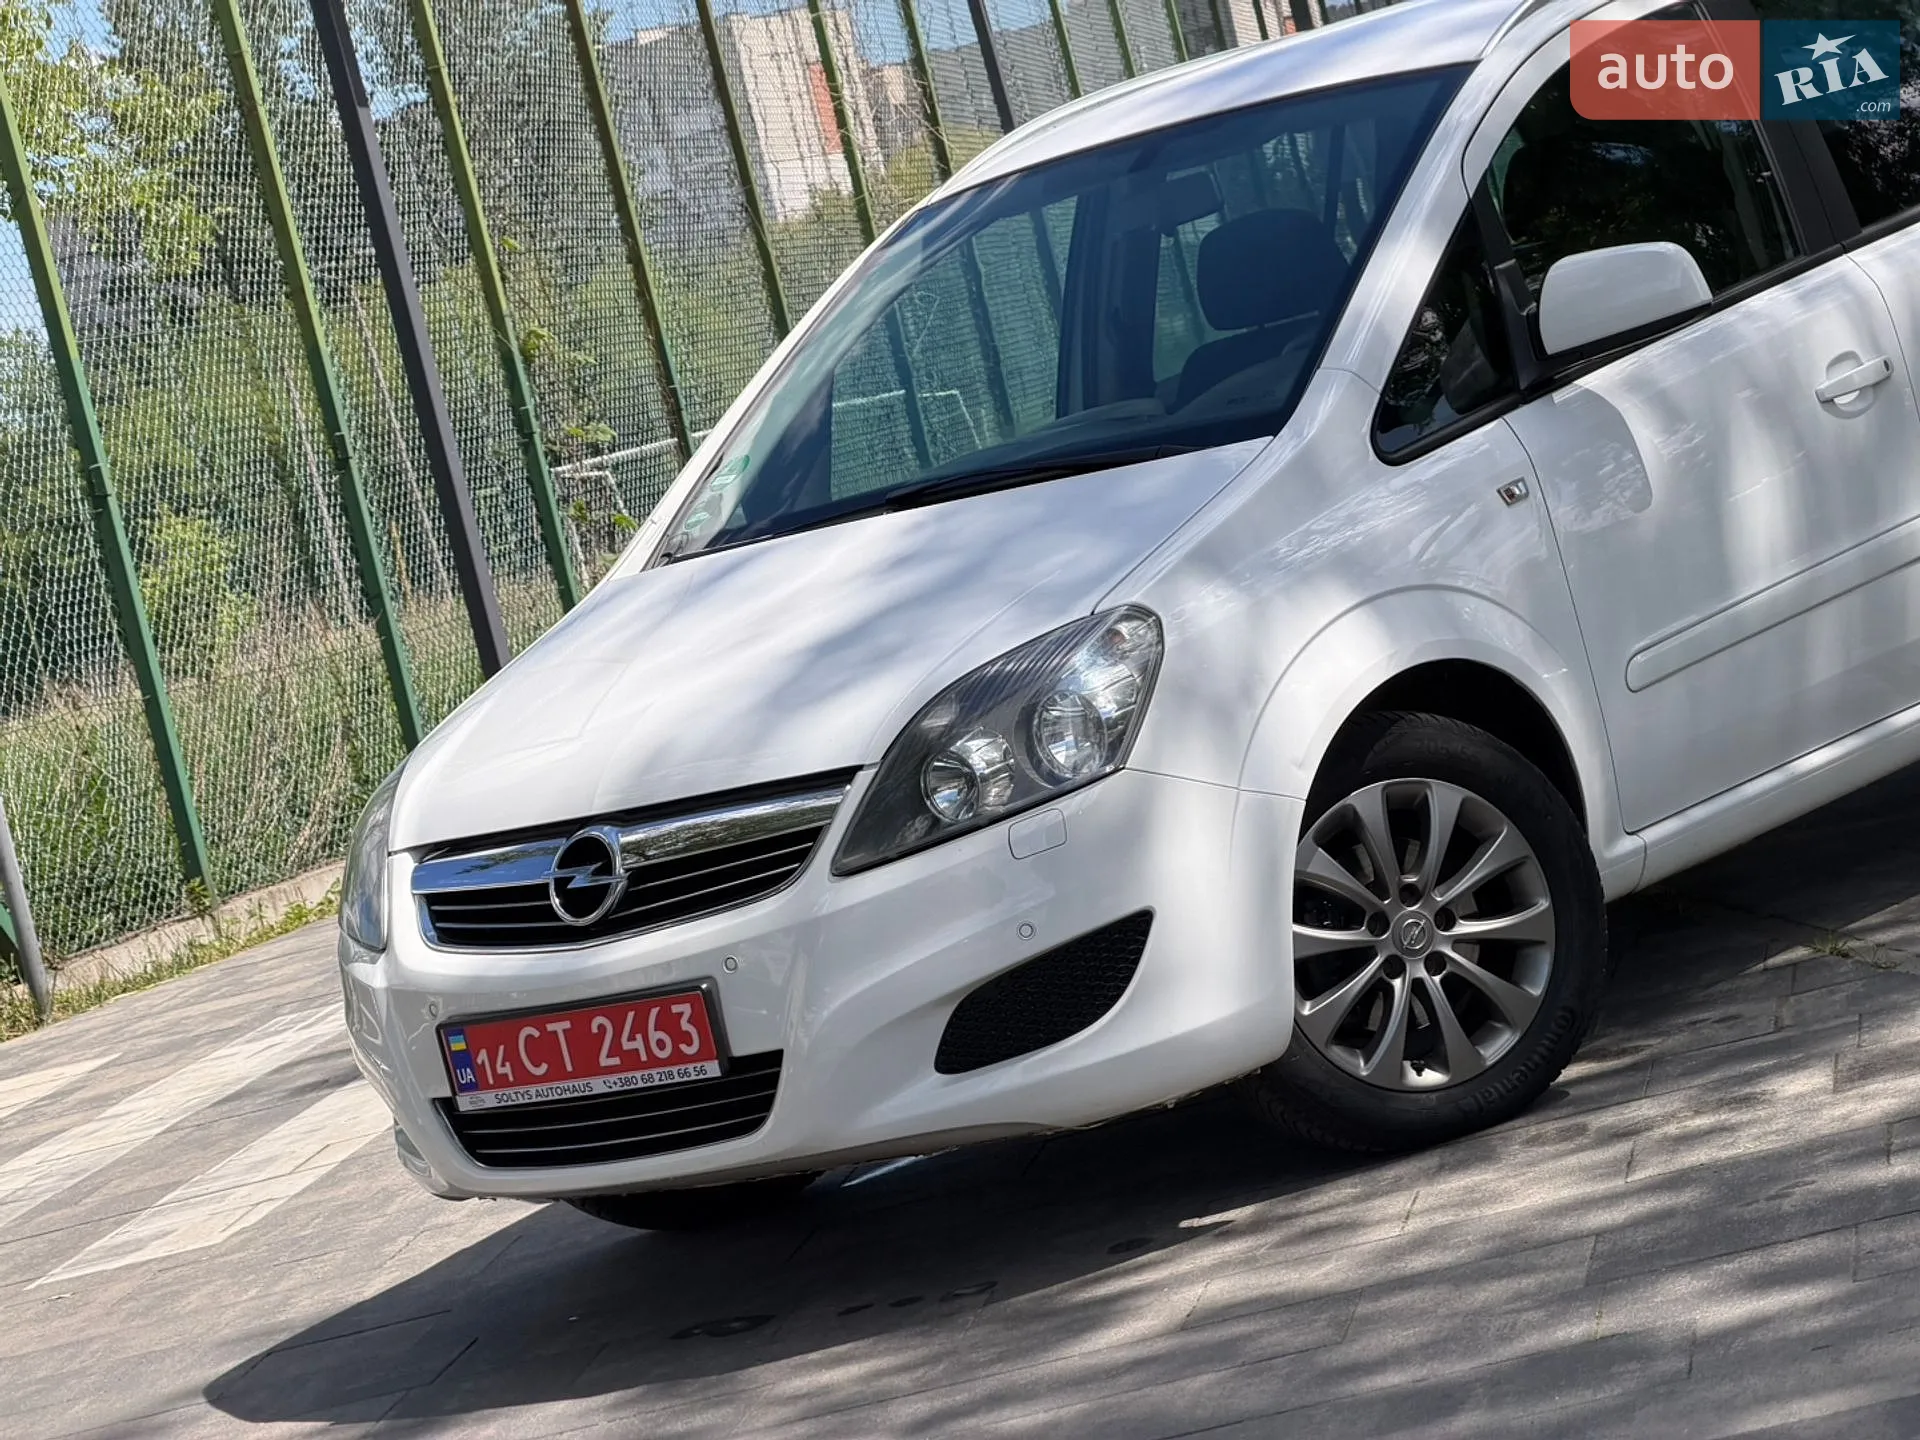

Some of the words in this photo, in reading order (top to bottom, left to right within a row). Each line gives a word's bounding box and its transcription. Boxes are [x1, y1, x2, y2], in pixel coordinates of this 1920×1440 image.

[591, 1003, 700, 1068] 2463
[456, 1067, 476, 1085] UA
[494, 1089, 533, 1104] SOLTYS
[535, 1082, 594, 1099] AUTOHAUS
